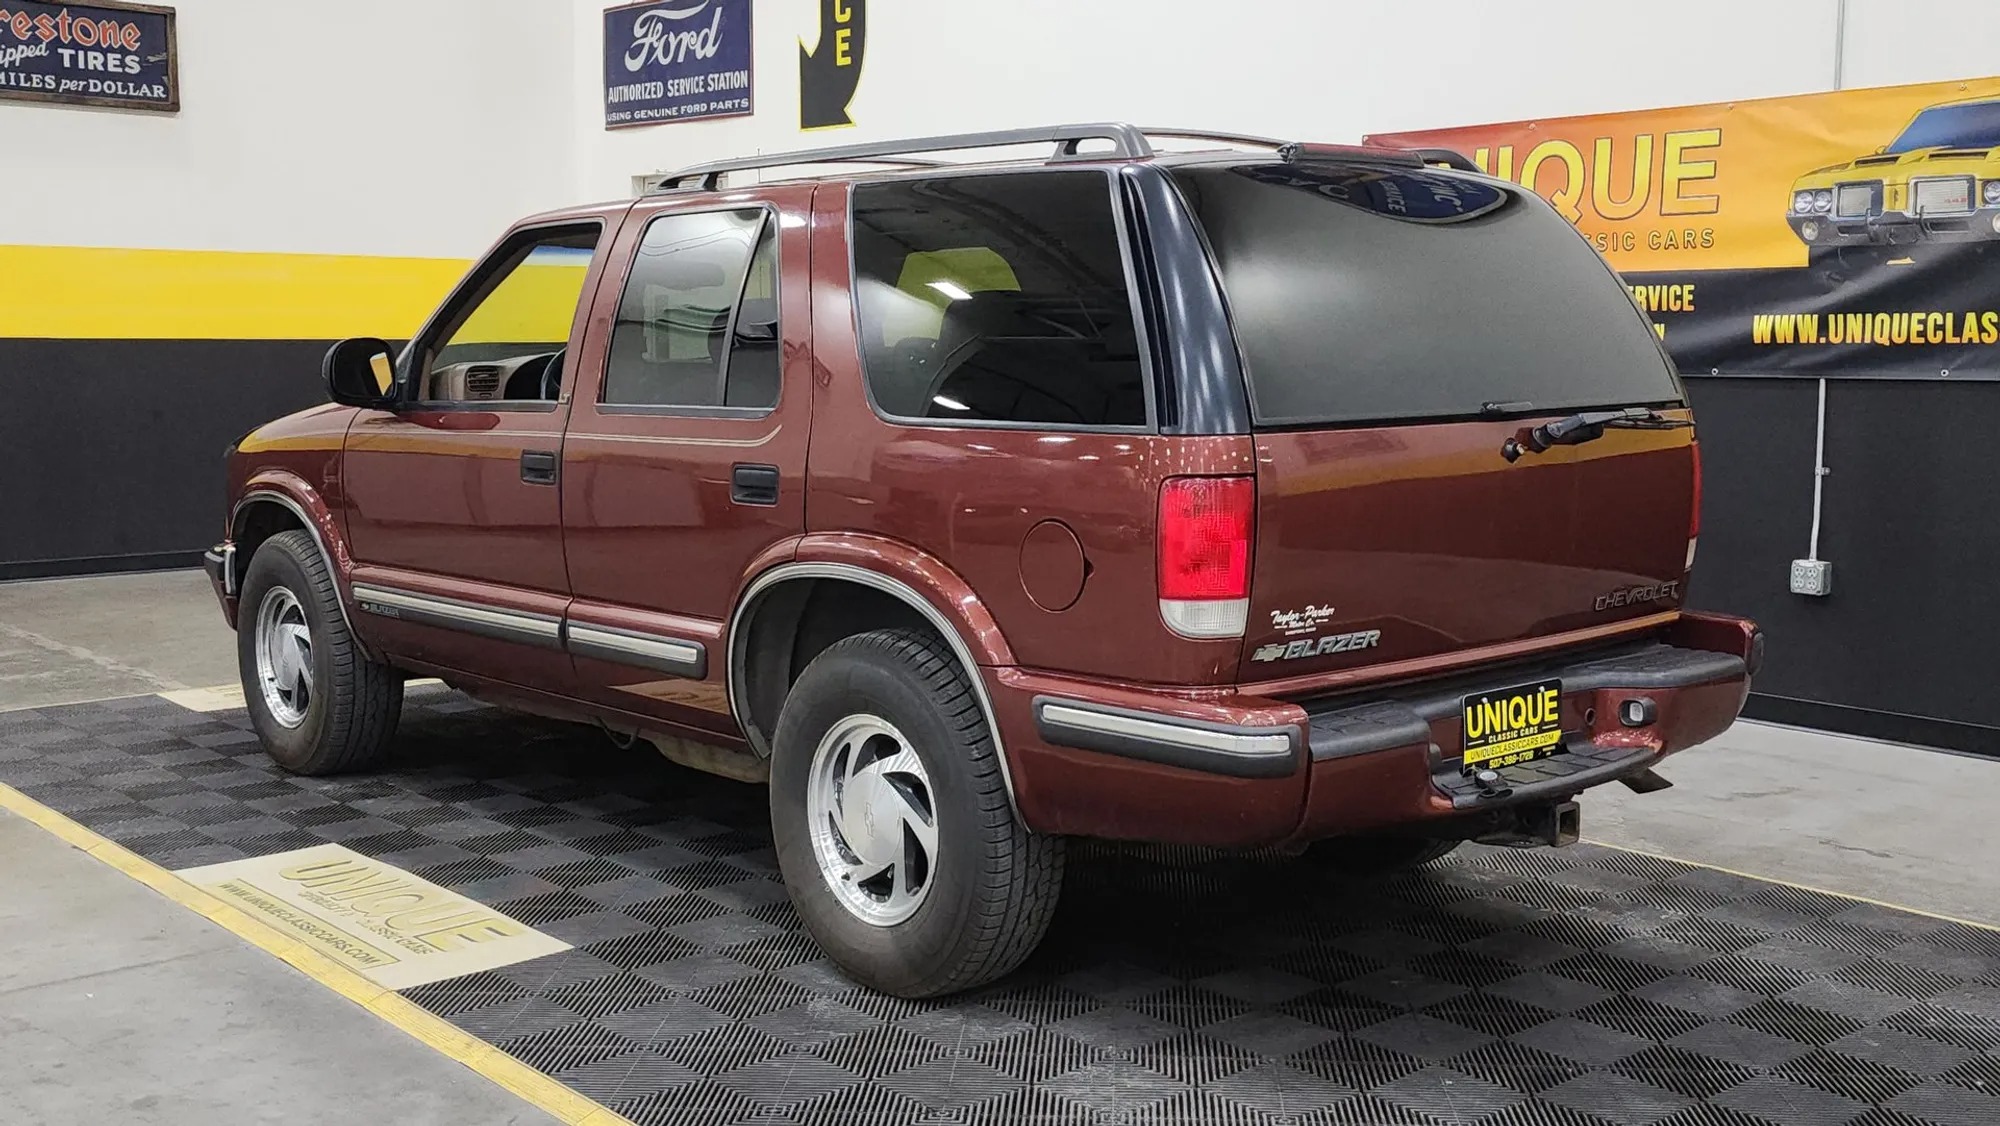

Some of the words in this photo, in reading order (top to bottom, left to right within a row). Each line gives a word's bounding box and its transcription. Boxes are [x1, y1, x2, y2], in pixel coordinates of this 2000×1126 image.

[624, 0, 723, 72] Ford
[57, 48, 141, 74] TIRES
[59, 78, 88, 93] per
[88, 79, 167, 98] DOLLAR
[608, 81, 663, 104] AUTHORIZED
[667, 76, 705, 98] SERVICE
[707, 70, 749, 92] STATION
[607, 111, 631, 121] USING
[634, 107, 678, 119] GENUINE
[681, 103, 708, 115] FORD
[710, 98, 749, 111] PARTS
[1647, 228, 1715, 250] CARS
[1626, 284, 1695, 312] RVICE
[1595, 580, 1679, 611] CHEVROLET
[1270, 604, 1335, 625] Taylor-Parker
[1284, 630, 1381, 660] BLAZER
[1466, 689, 1559, 738] UNIQUE
[1470, 733, 1555, 760] UNIQUECLASSICCARS.COM
[1489, 730, 1518, 743] CLASSIC
[1520, 726, 1538, 737] CARS
[279, 858, 527, 952] UNIQUE
